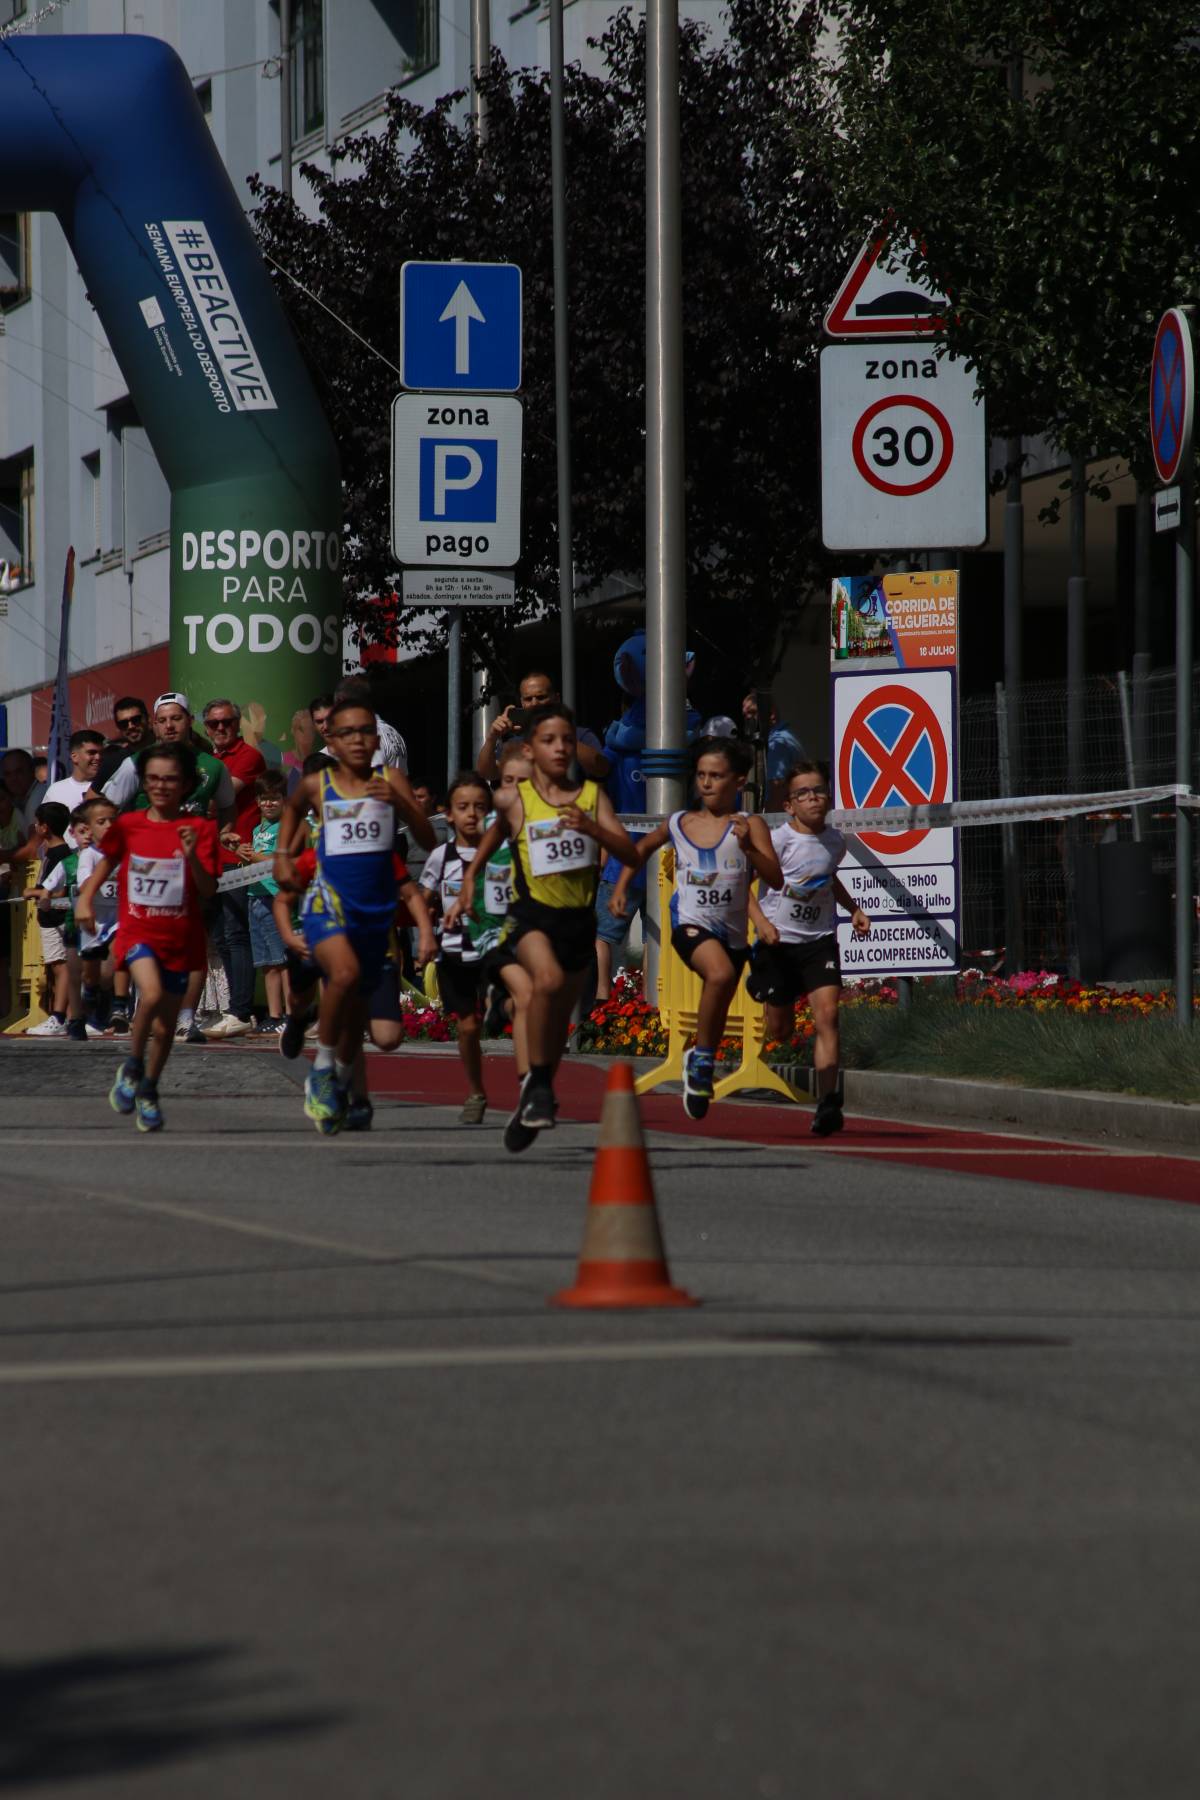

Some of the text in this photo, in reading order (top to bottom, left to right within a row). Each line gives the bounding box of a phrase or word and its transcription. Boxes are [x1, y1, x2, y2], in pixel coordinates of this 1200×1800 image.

[145, 223, 231, 413] SEMANA EUROPEIA DO DESPORTO
[175, 228, 268, 401] #BEACTIVE
[865, 358, 938, 379] zona
[427, 407, 489, 426] zona
[872, 425, 934, 467] 30
[433, 444, 483, 516] P
[182, 529, 339, 572] DESPORTO
[426, 535, 489, 557] pago
[223, 575, 308, 603] PARA
[885, 597, 955, 614] CORRIDA DE
[885, 613, 955, 630] FELGUEIRAS
[183, 613, 338, 656] TODOS
[928, 645, 955, 656] JULHO
[341, 821, 380, 840] 369
[546, 837, 585, 860] 389
[134, 877, 169, 895] 377
[852, 877, 861, 890] 15
[862, 875, 888, 892] julho
[907, 874, 937, 887] 19h00
[697, 889, 732, 905] 384
[882, 896, 895, 908] do
[896, 894, 911, 907] dia
[913, 894, 923, 907] 18
[925, 893, 951, 910] julho
[790, 904, 821, 921] 380
[933, 927, 942, 940] A
[844, 943, 949, 963] SUA COMPREENSÃO
